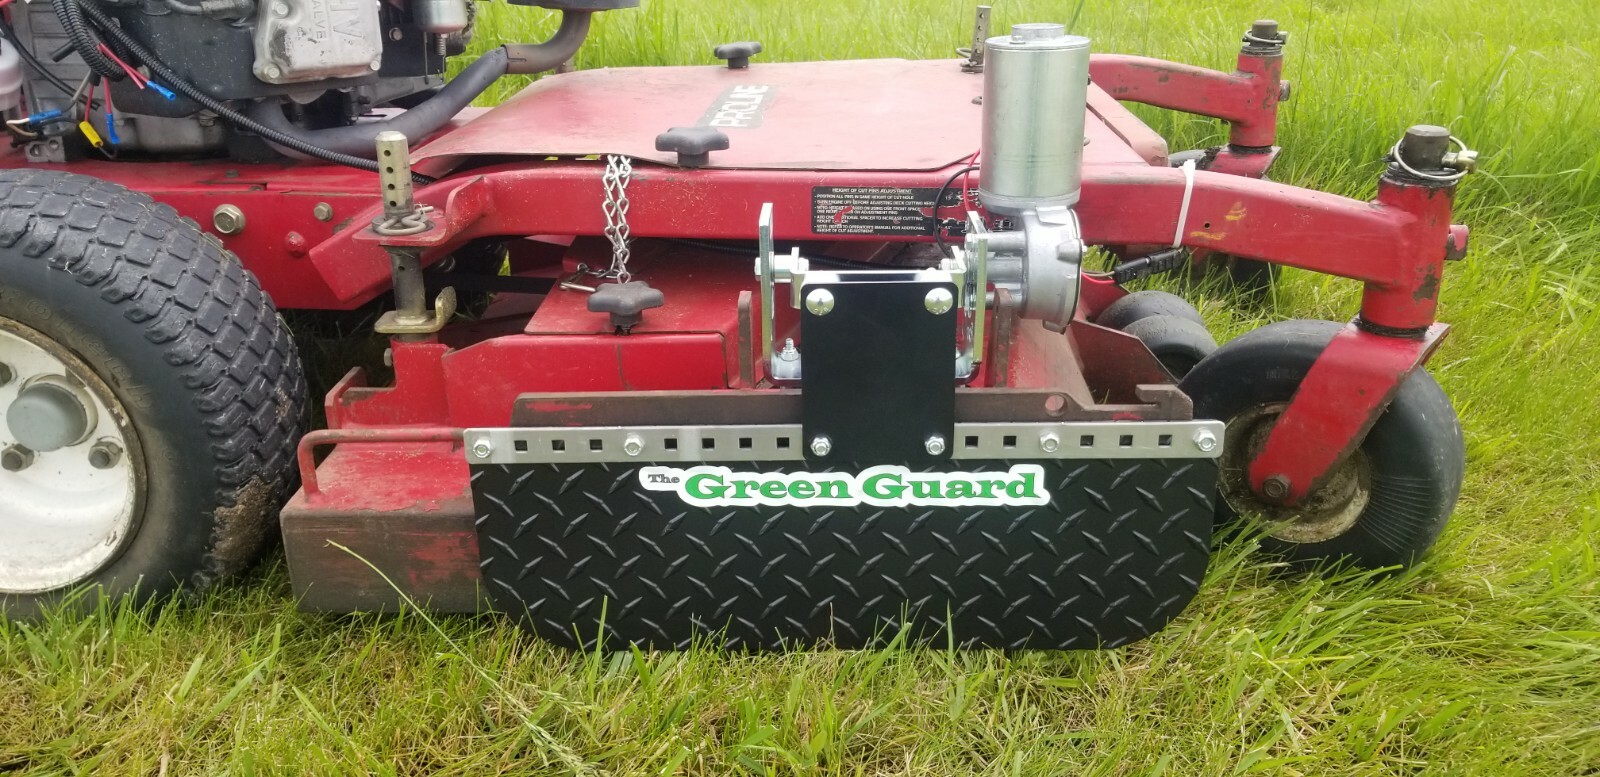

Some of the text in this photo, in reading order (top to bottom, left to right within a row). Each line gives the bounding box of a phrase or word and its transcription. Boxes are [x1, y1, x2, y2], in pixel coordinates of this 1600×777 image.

[709, 85, 769, 127] PROLINE
[647, 472, 1041, 500] The Green Guard
